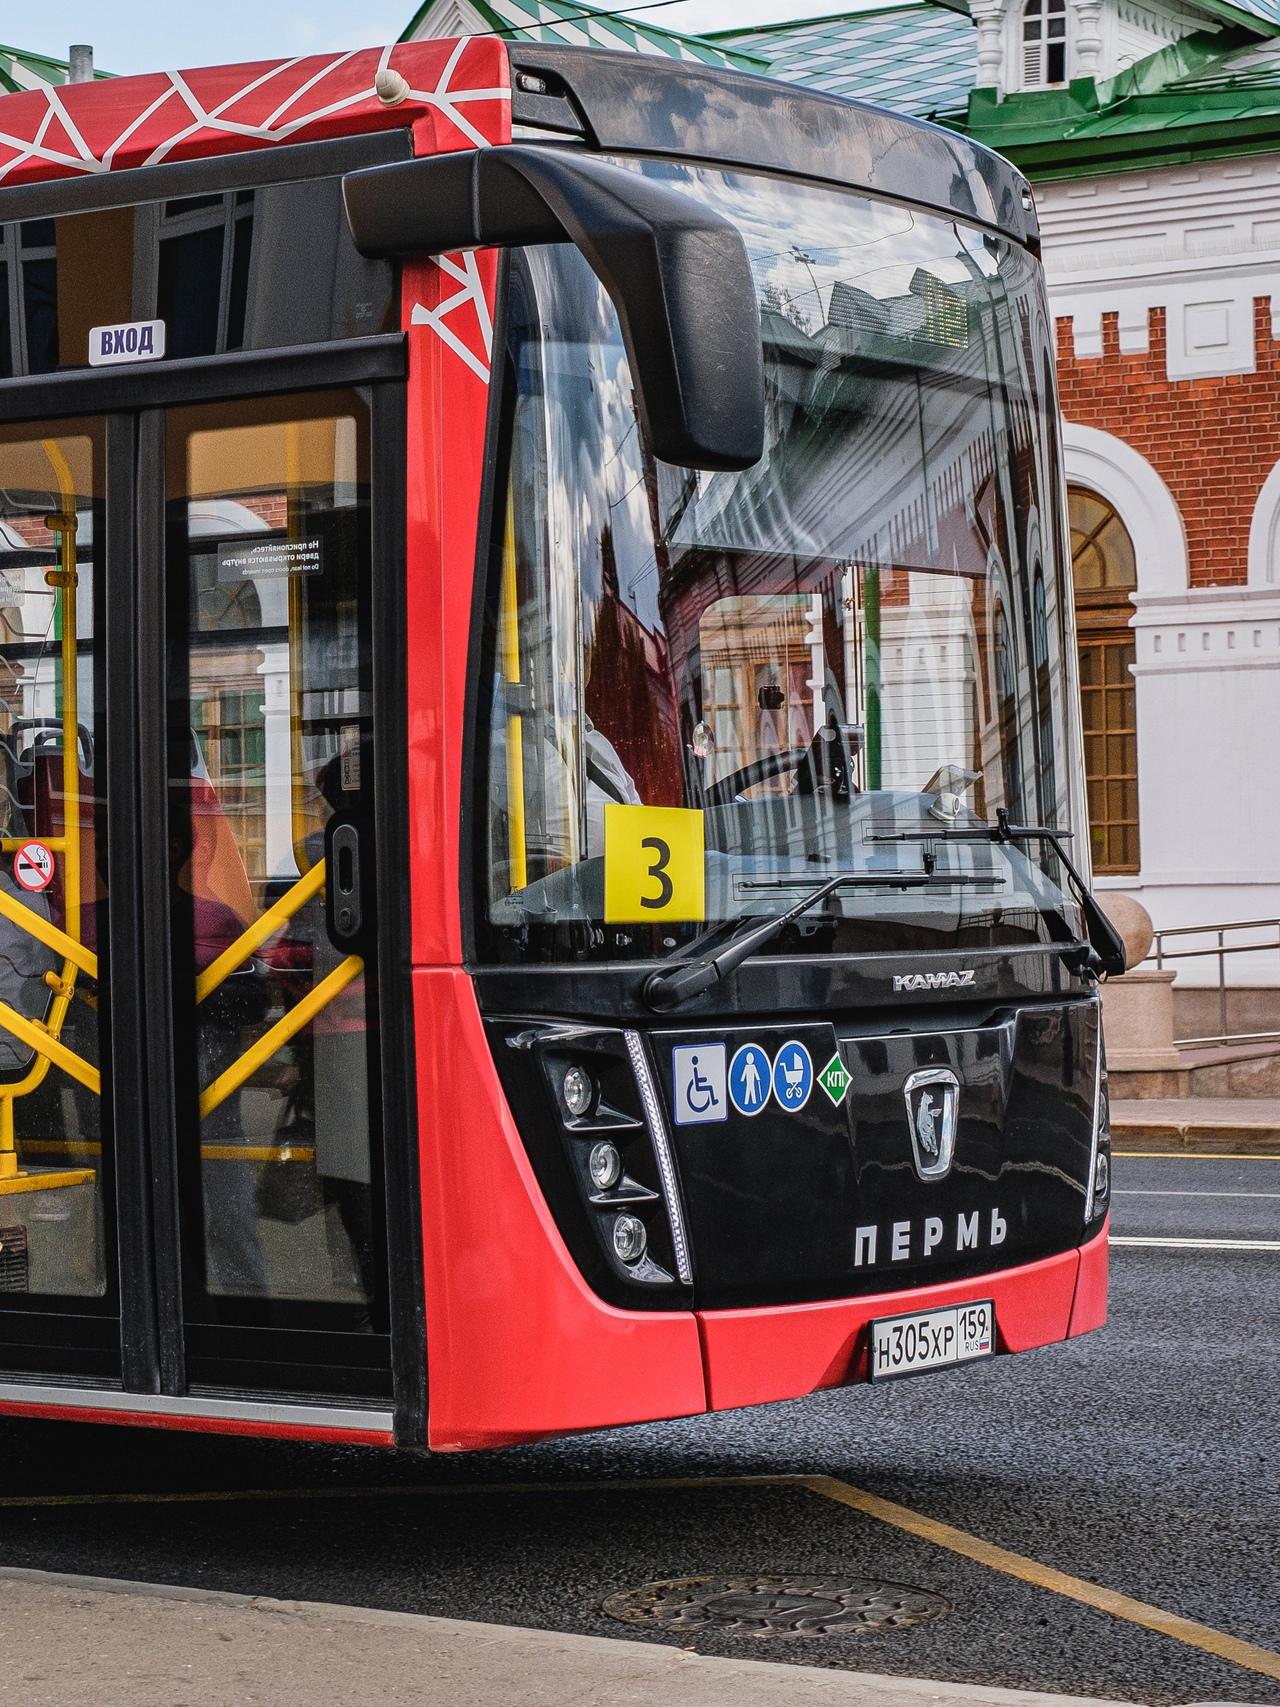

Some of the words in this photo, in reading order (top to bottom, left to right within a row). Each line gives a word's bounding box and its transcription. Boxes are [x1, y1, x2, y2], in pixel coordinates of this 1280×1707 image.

[101, 326, 153, 355] ВХОД
[640, 837, 674, 909] 3
[892, 970, 976, 992] KAMAZ
[854, 1207, 1008, 1267] ПЕРМЬ
[878, 1321, 955, 1369] Н305ХР
[959, 1308, 987, 1340] 159
[964, 1339, 980, 1352] RUS
